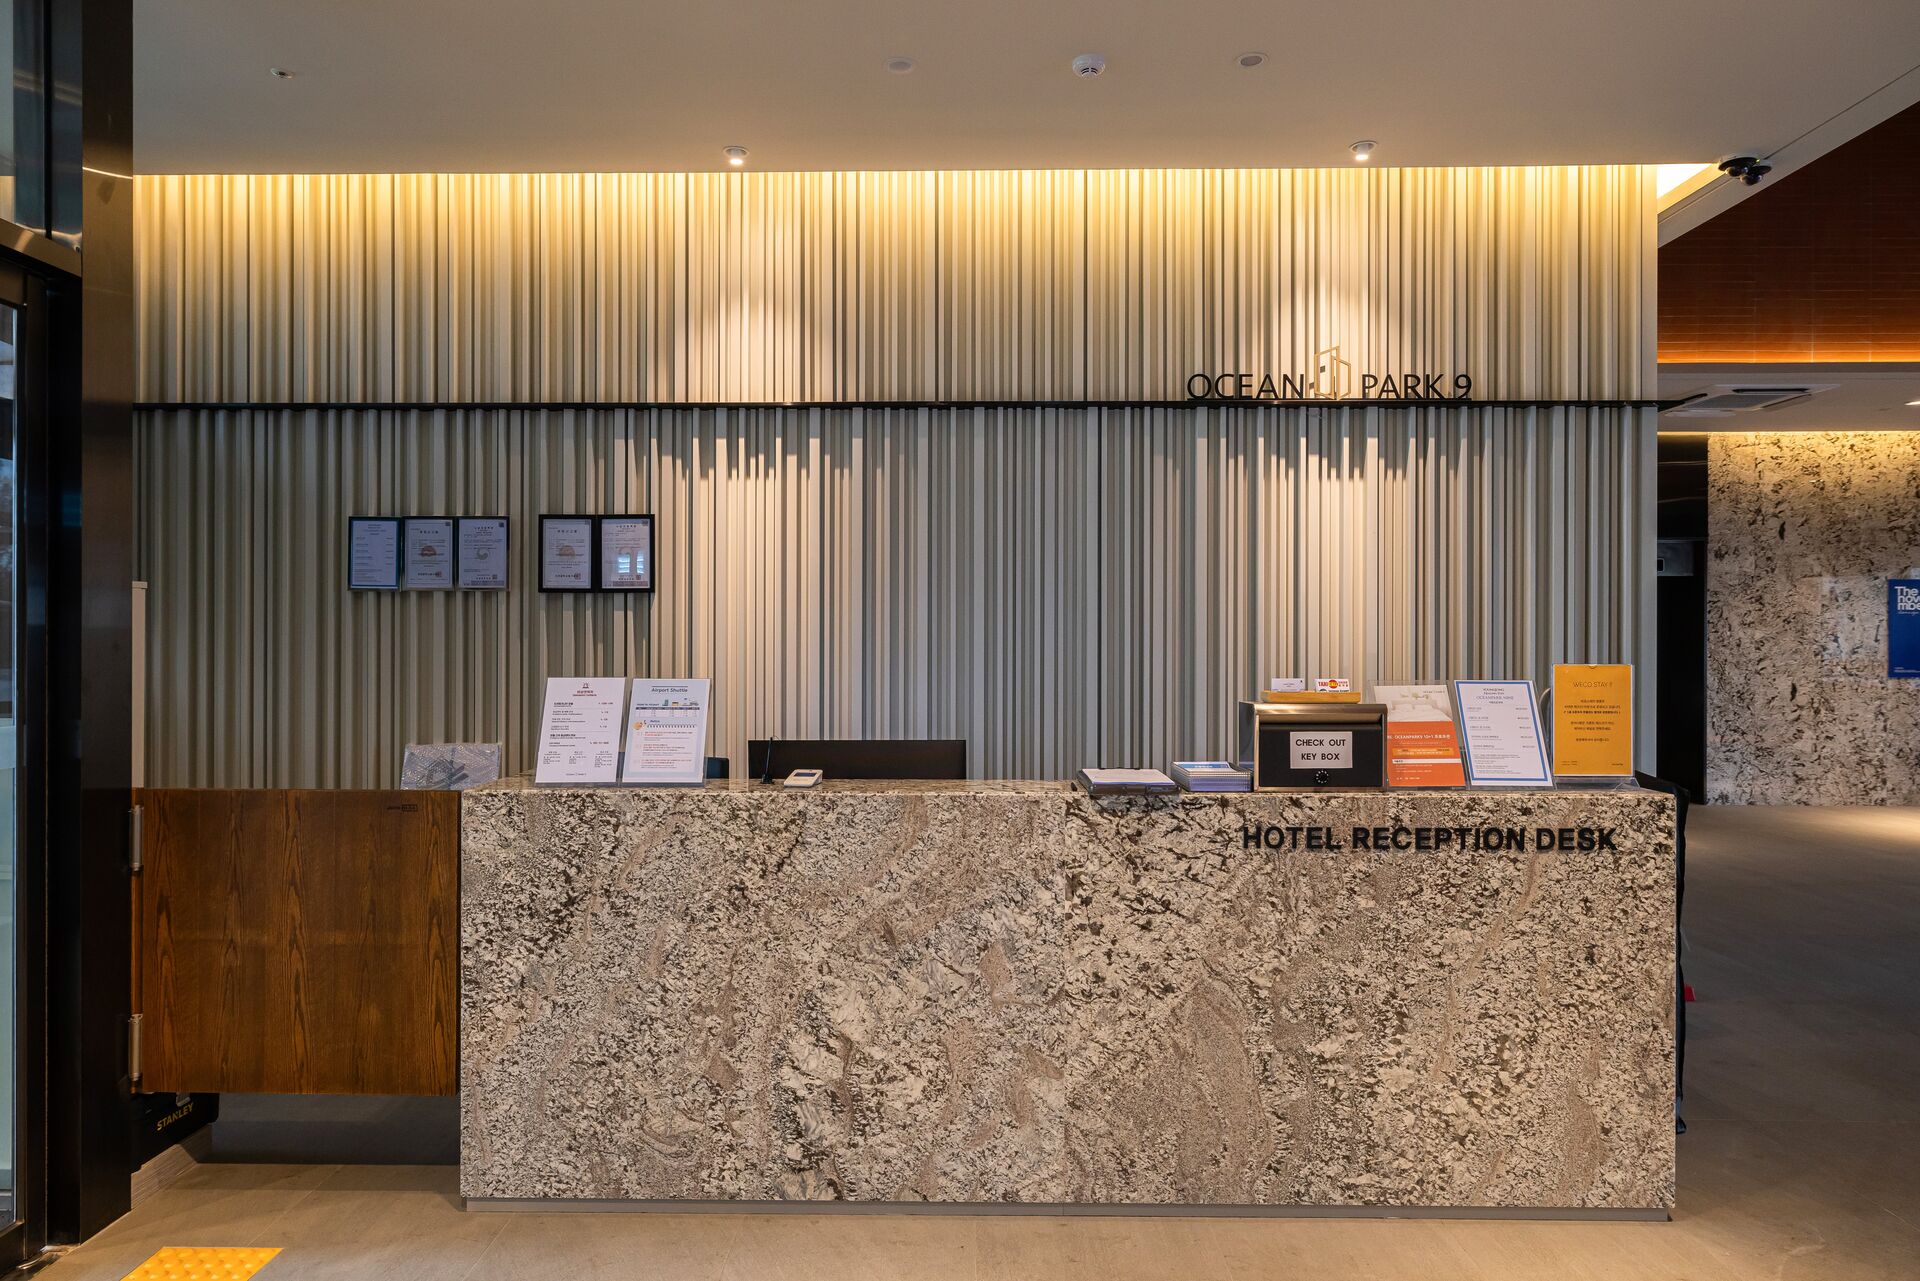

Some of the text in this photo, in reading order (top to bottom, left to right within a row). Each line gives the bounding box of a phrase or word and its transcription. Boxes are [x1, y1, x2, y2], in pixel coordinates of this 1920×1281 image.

[1187, 373, 1473, 399] OCEAN PARK 9
[1894, 586, 1918, 596] The
[1897, 595, 1920, 603] nov
[1295, 738, 1346, 747] CHECK OUT
[1301, 752, 1340, 761] KEY BOX
[1242, 827, 1618, 850] HOTEL RECEPTION DESK
[156, 1102, 194, 1131] STANLEY
